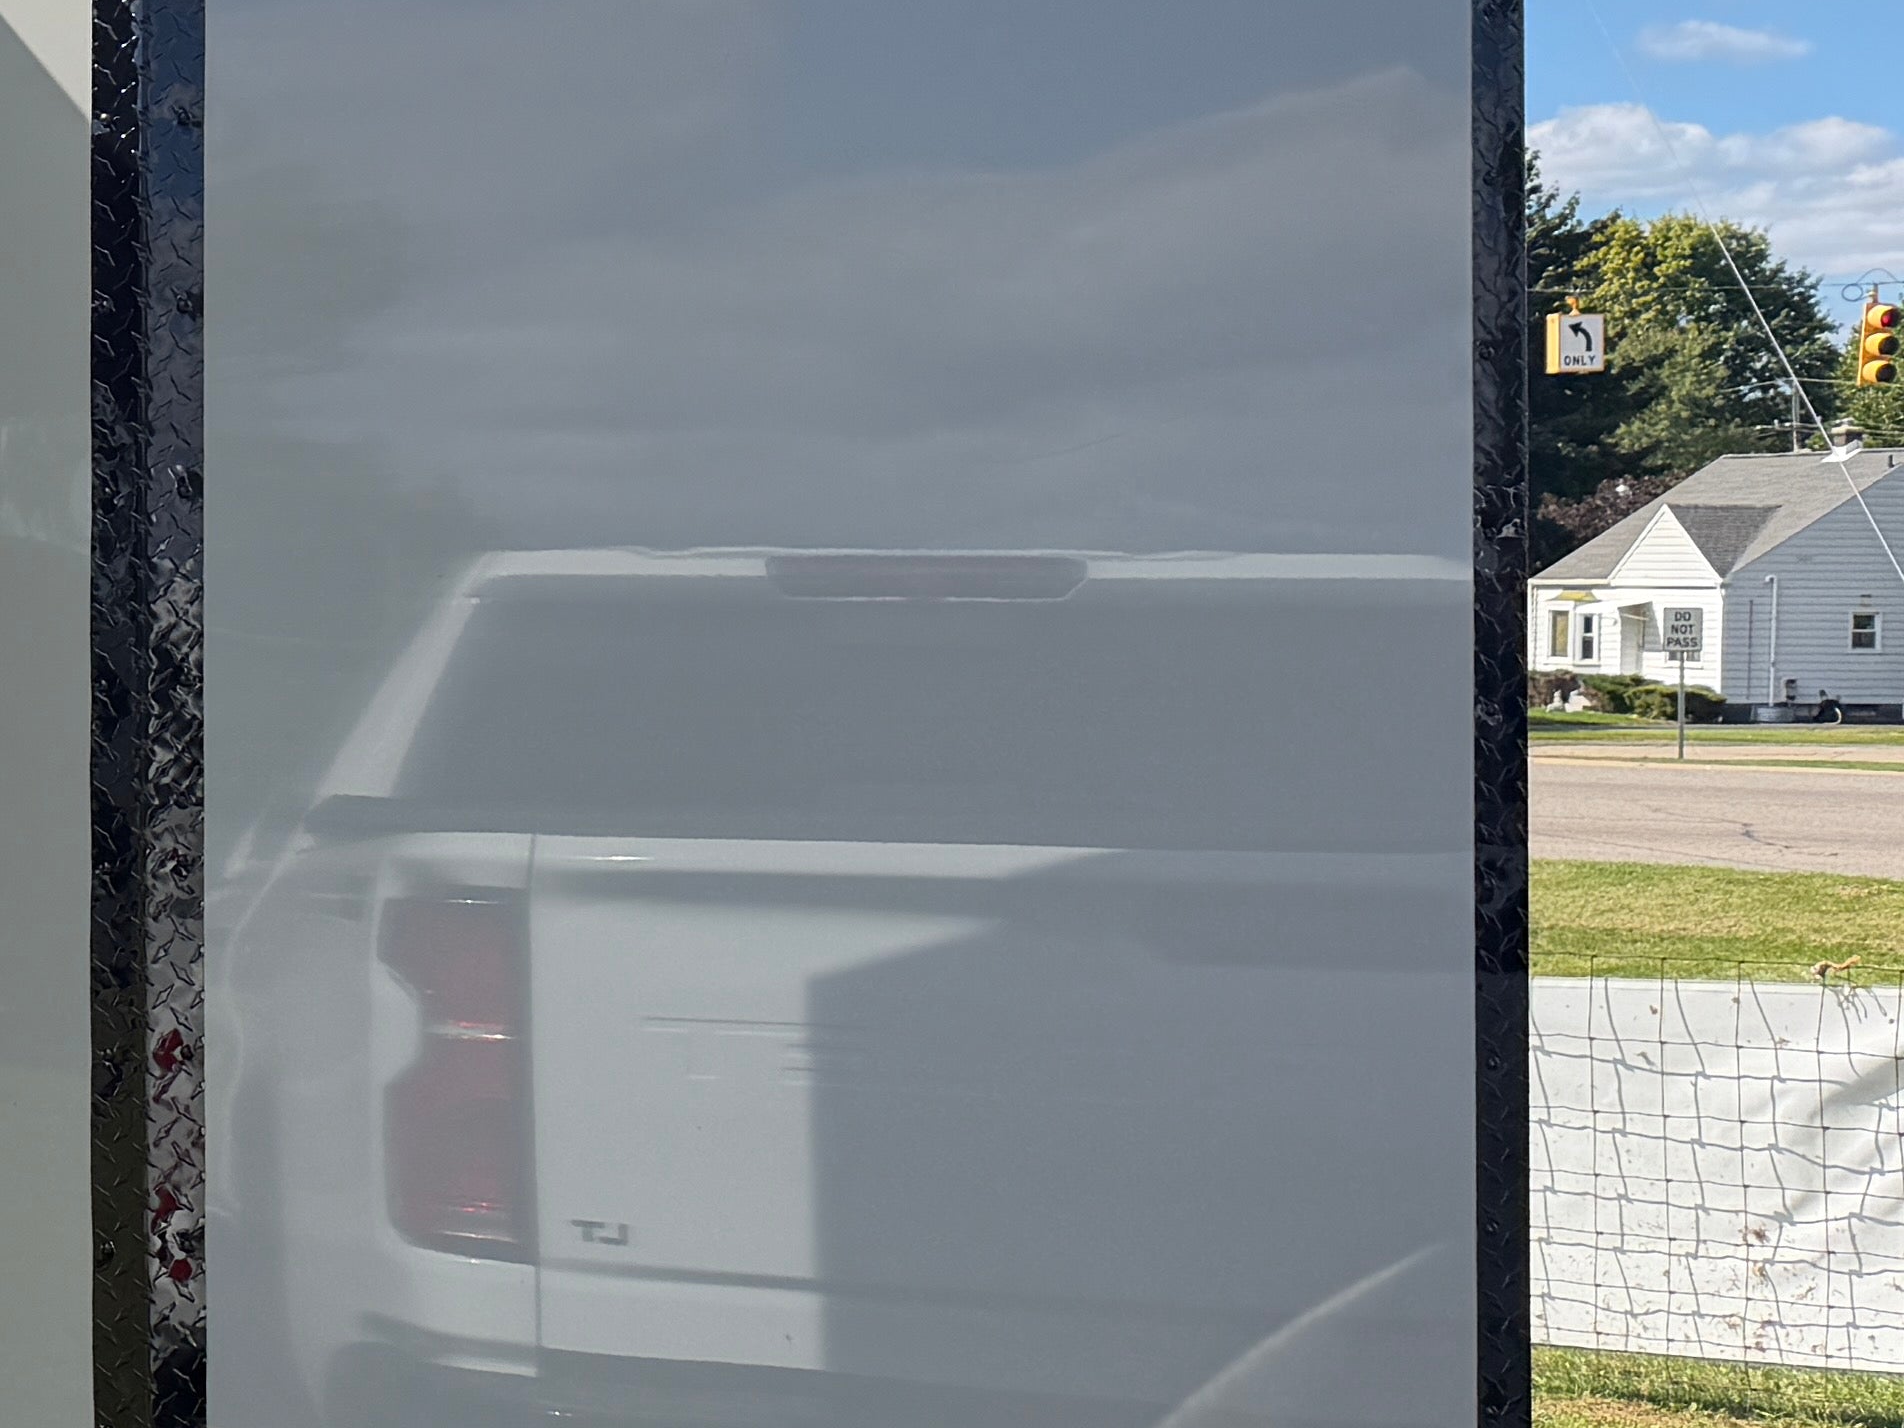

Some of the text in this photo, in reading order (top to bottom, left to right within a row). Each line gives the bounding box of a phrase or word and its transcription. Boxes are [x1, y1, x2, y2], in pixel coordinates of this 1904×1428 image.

[1564, 355, 1596, 366] ONLY
[1674, 611, 1691, 622] DO
[1671, 624, 1695, 634] NOT
[1667, 637, 1698, 648] PASS
